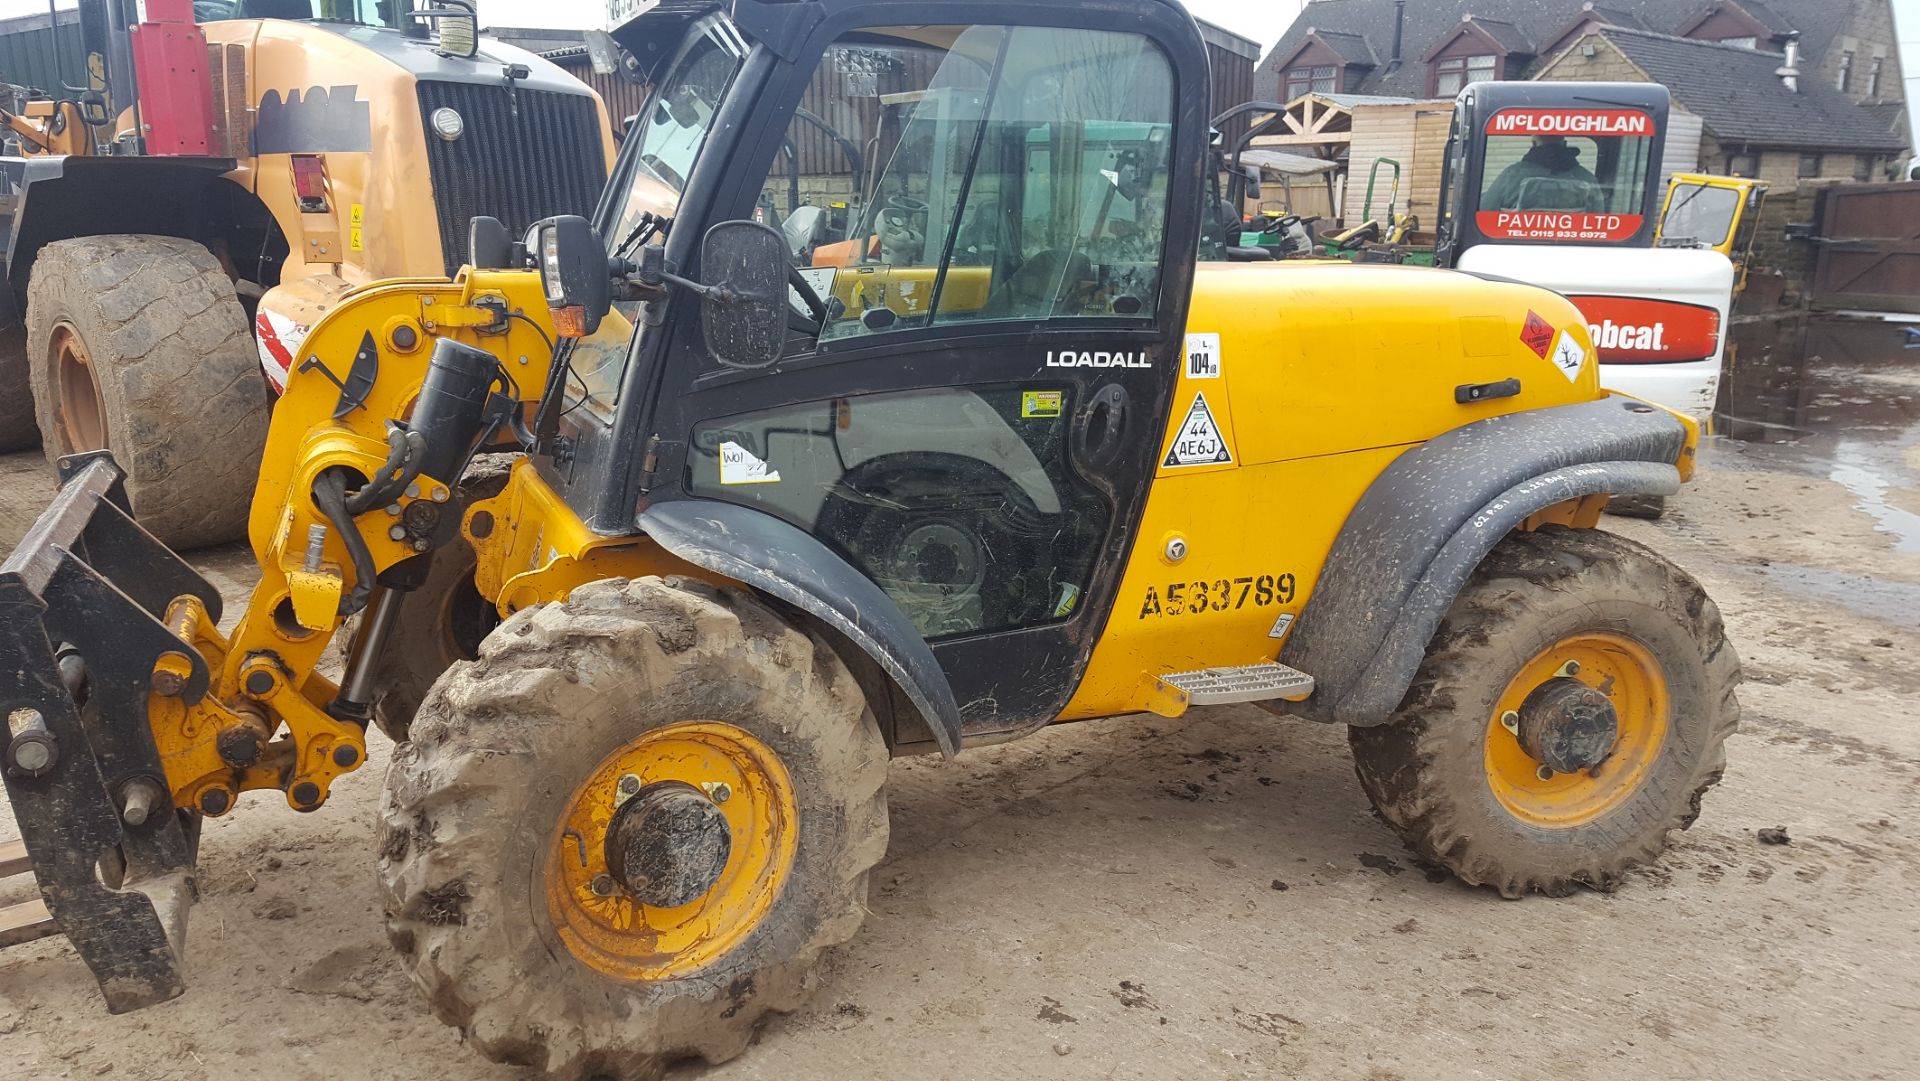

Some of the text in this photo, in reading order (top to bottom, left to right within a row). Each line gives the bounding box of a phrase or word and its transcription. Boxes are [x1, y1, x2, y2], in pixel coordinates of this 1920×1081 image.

[1497, 213, 1621, 230] PAVING LTD
[1530, 230, 1554, 238] 0115
[1580, 231, 1607, 239] 6972
[1588, 320, 1664, 350] obcat
[1046, 351, 1152, 368] LOADALL
[1190, 353, 1209, 374] 104
[1190, 421, 1207, 437] 44
[1179, 439, 1216, 456] AE6J
[1473, 516, 1489, 528] 62
